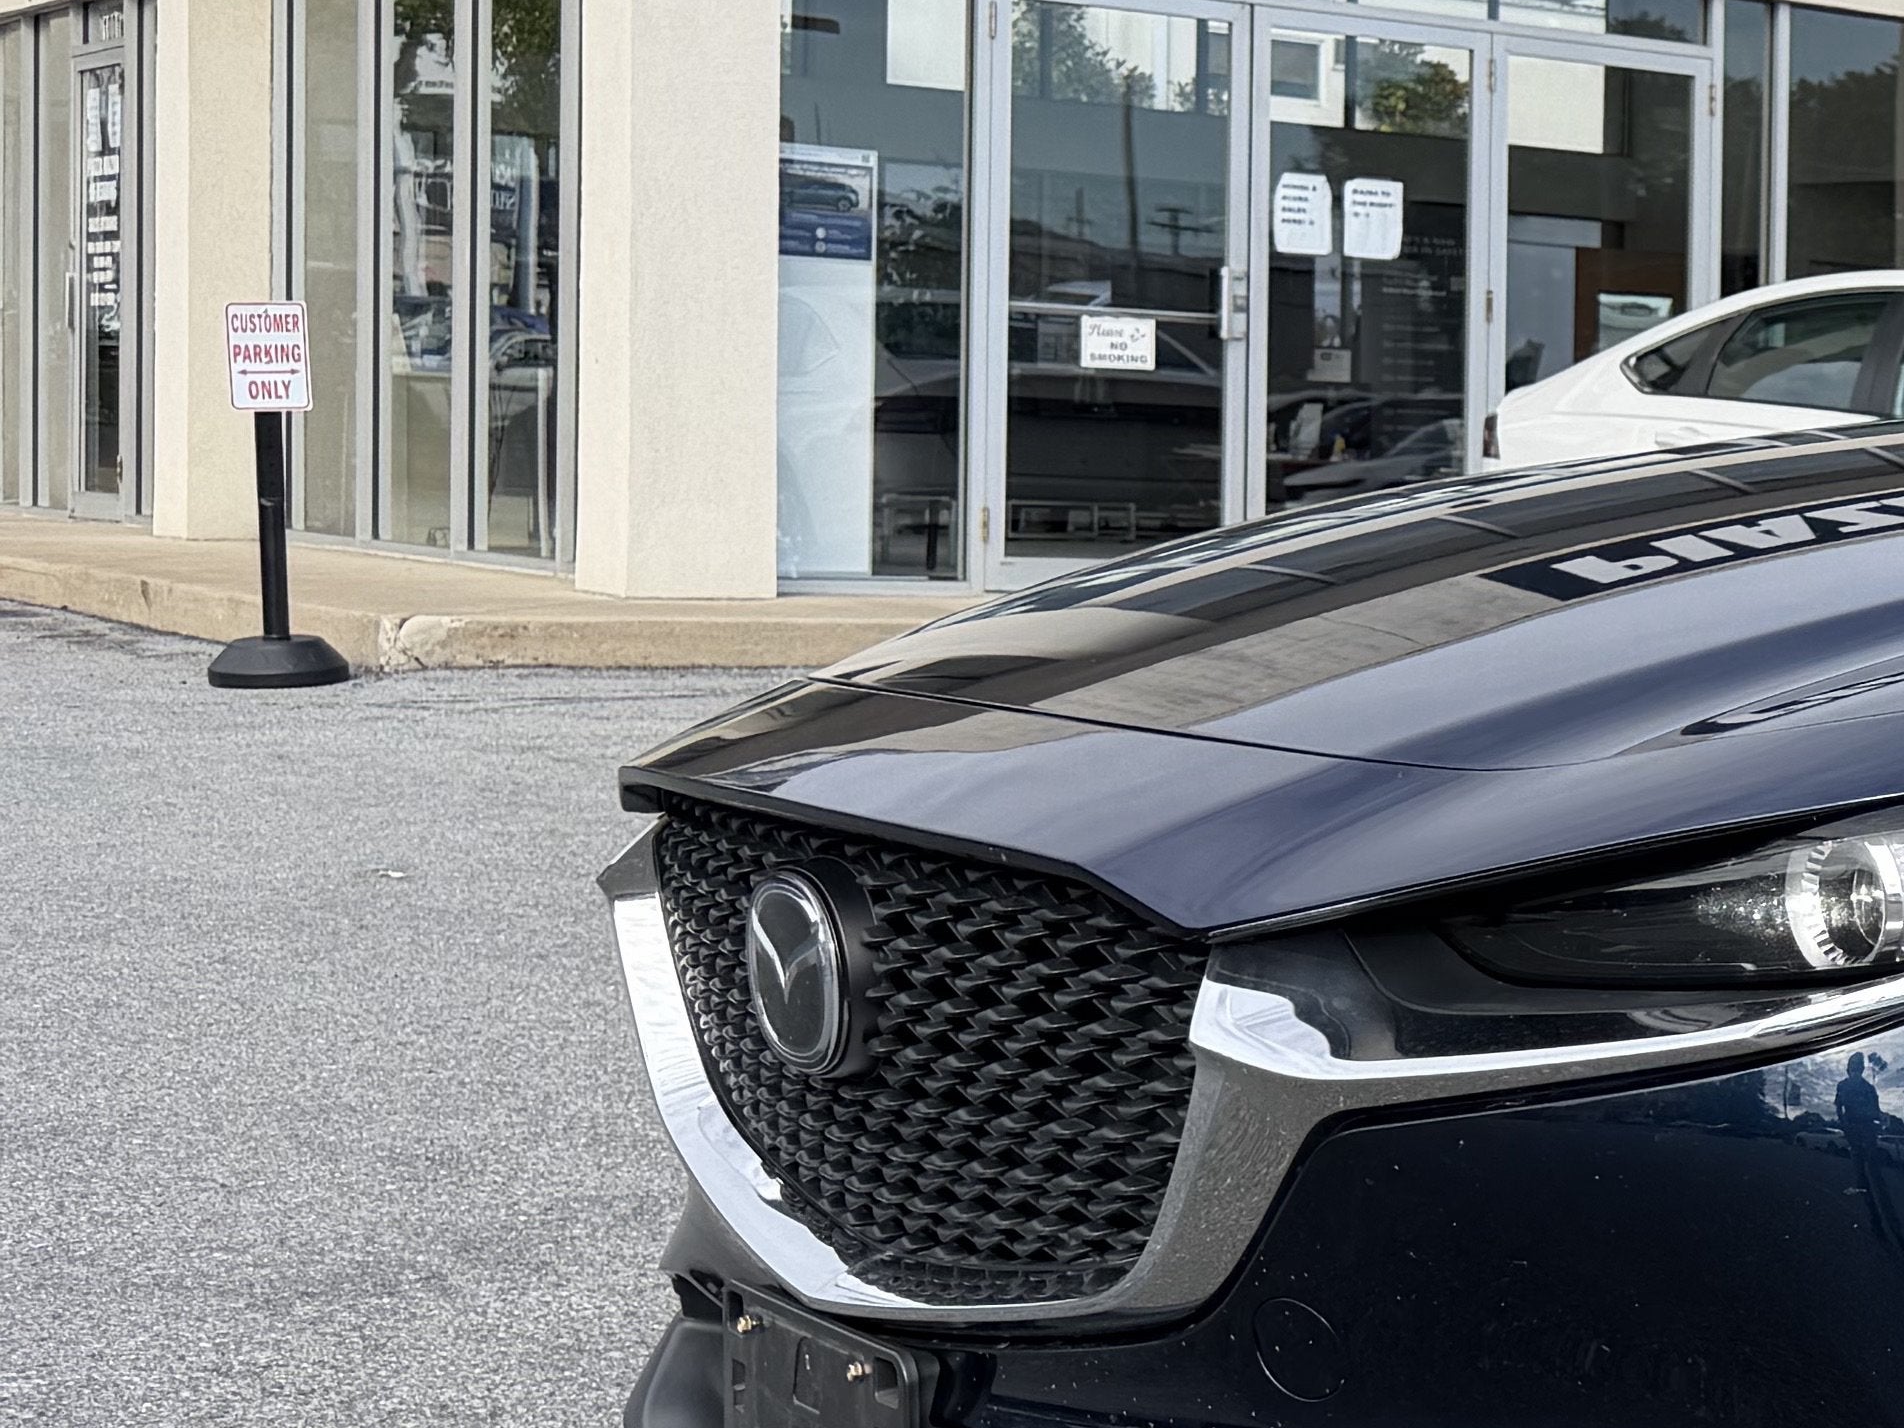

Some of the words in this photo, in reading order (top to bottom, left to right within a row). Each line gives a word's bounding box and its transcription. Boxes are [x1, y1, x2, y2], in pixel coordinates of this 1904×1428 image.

[231, 313, 300, 333] CUSTOMER
[233, 344, 301, 364] PARKING
[1110, 341, 1128, 351] NO
[1089, 352, 1148, 364] SMOKING
[248, 380, 292, 400] ONLY
